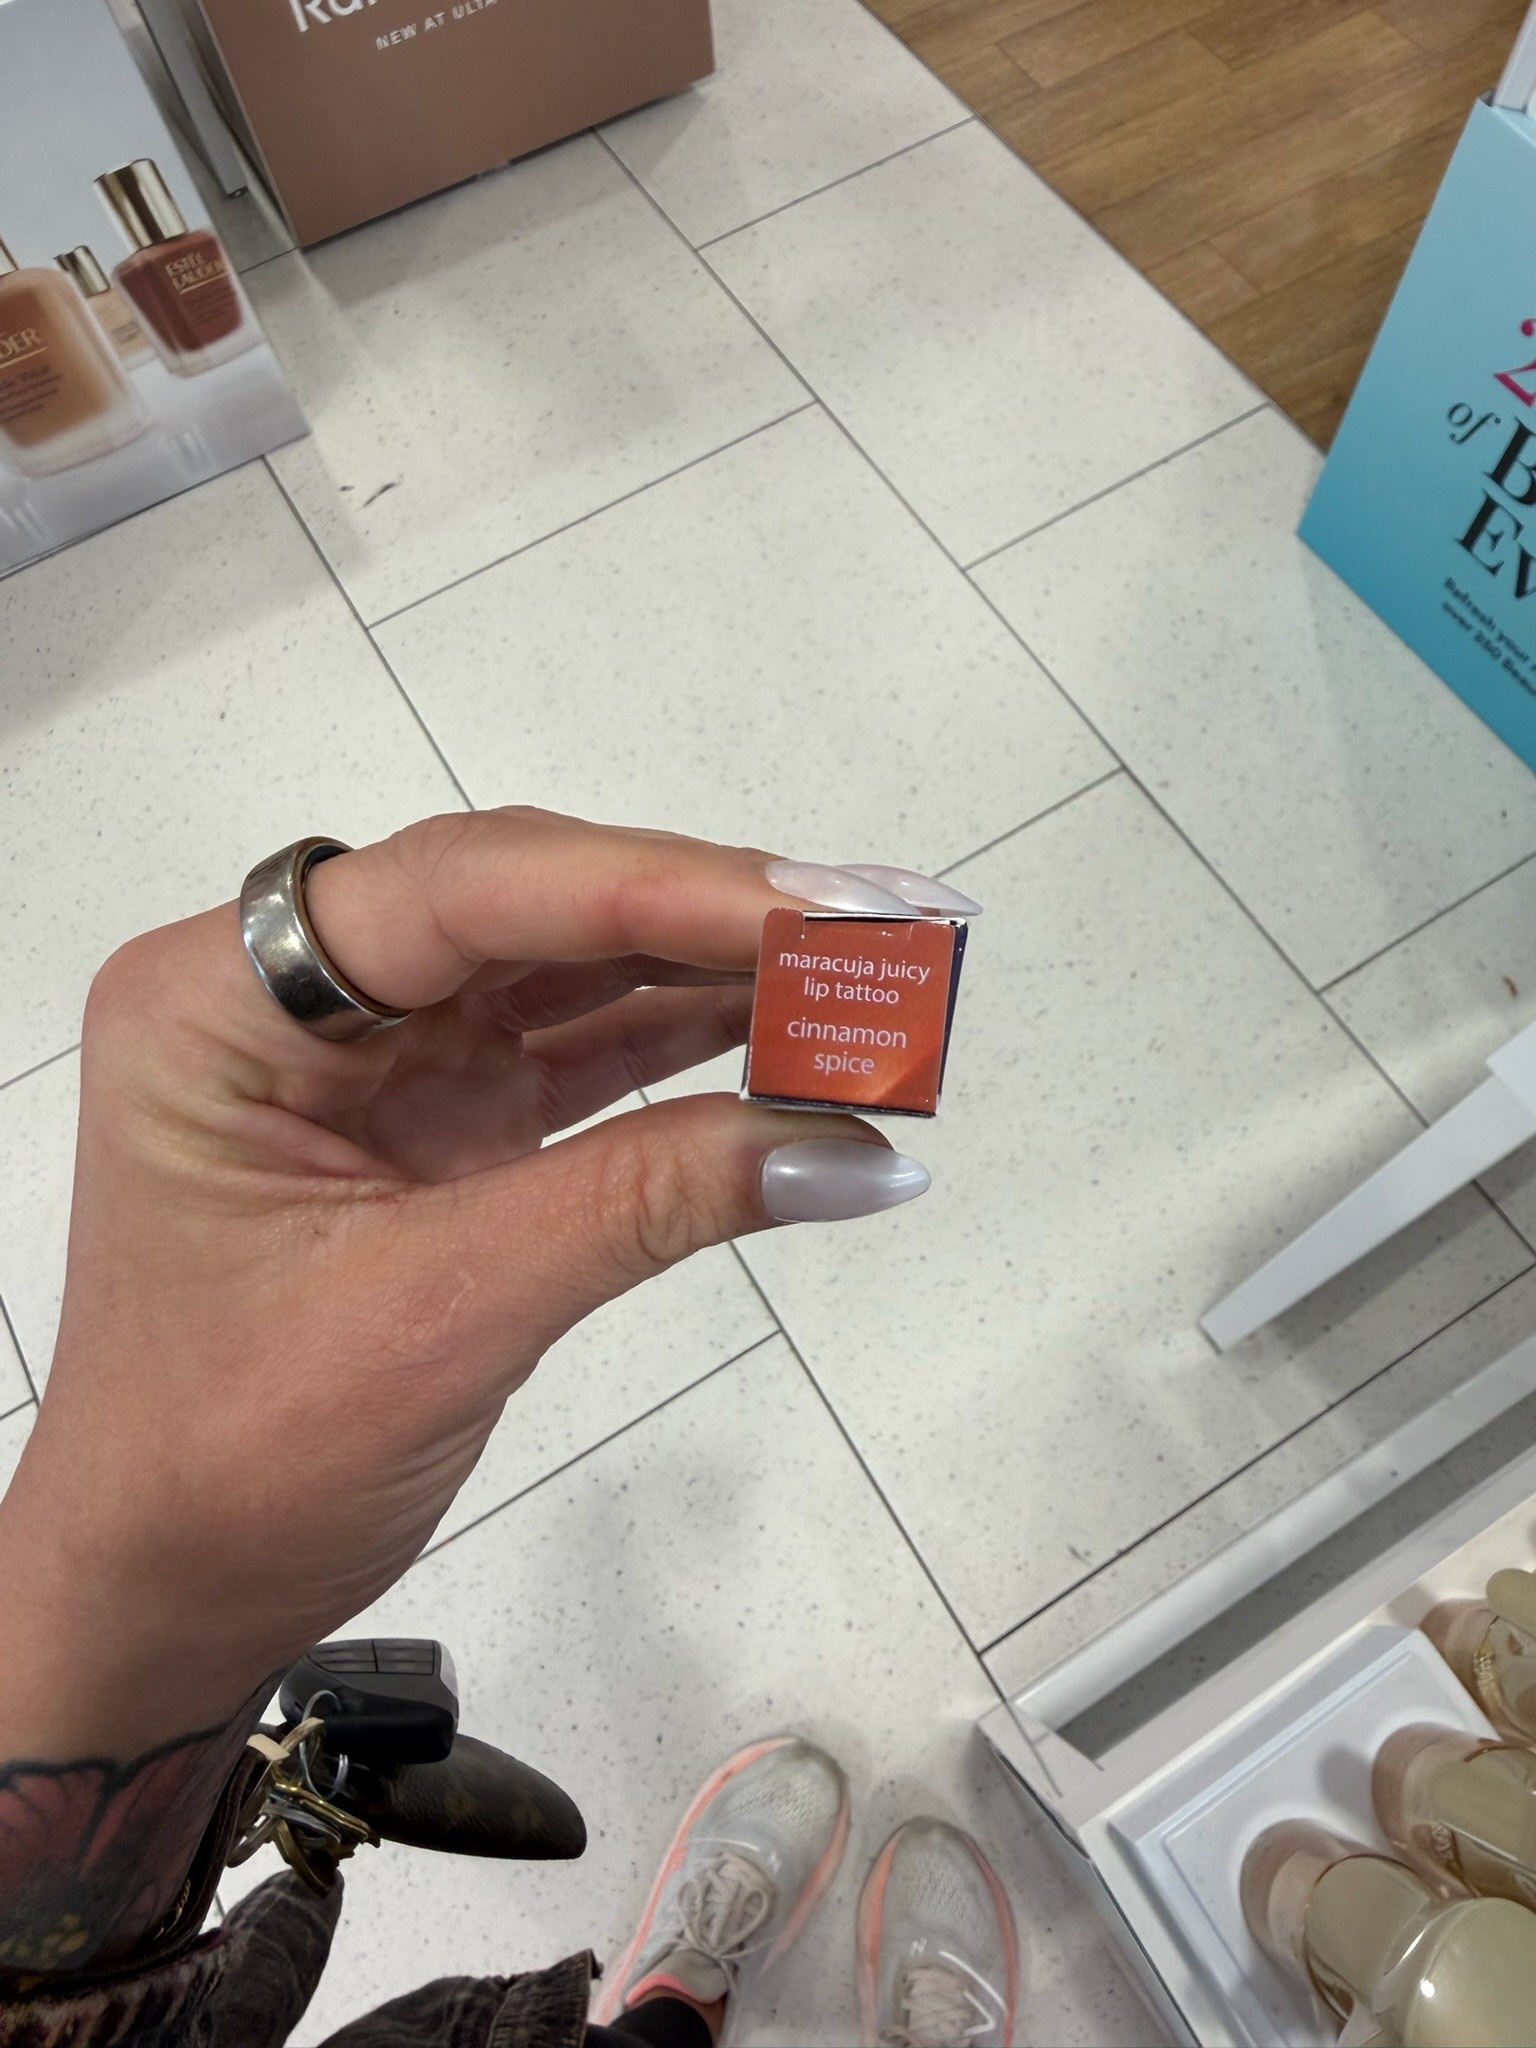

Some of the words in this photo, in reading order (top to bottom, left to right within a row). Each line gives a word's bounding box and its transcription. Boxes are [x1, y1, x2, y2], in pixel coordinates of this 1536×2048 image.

[375, 23, 417, 50] NEW
[424, 12, 446, 32] AT
[1447, 402, 1501, 445] of
[779, 951, 875, 978] maracuja
[877, 958, 931, 985] juicy
[803, 976, 830, 1002] lip
[835, 981, 899, 1005] tattoo
[787, 1017, 907, 1049] cinnamon
[813, 1051, 875, 1076] spice
